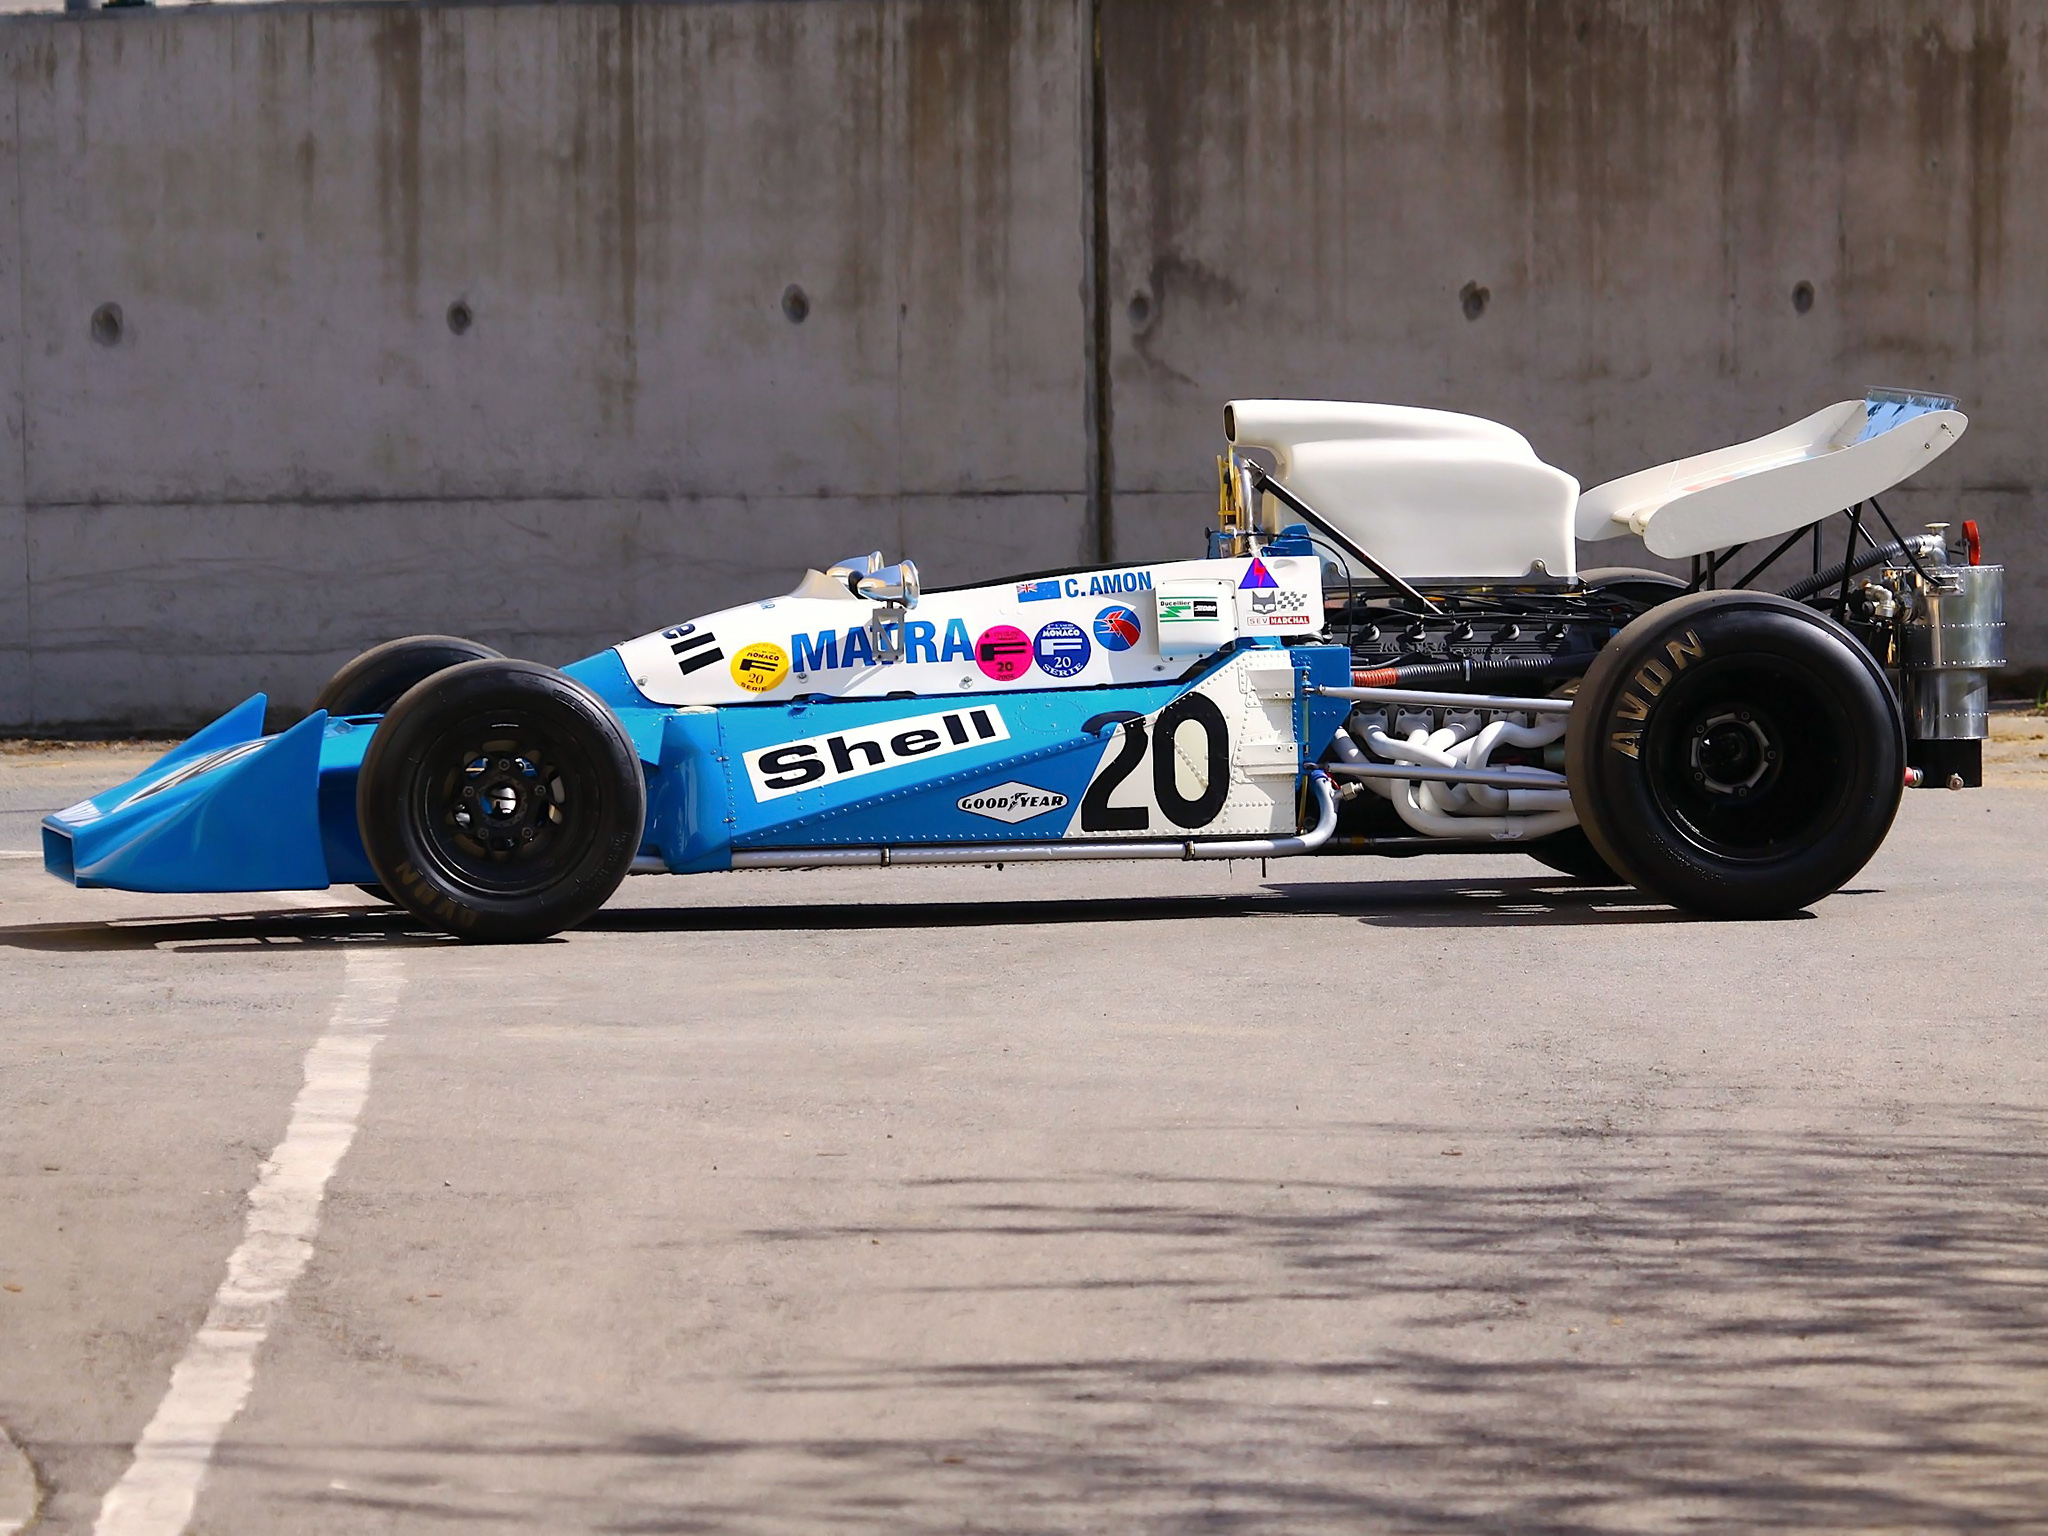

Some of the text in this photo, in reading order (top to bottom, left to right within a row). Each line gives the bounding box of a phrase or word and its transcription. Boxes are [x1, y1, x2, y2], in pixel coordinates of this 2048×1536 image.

[1089, 571, 1152, 596] AMON
[1270, 616, 1309, 625] MARCHAL
[1042, 629, 1081, 637] MONACO
[746, 652, 780, 662] MONACO
[1053, 656, 1071, 668] 20
[997, 661, 1014, 672] 20
[1042, 662, 1084, 677] SERIE
[748, 673, 764, 685] 20
[1610, 628, 1706, 760] AVON
[758, 709, 996, 790] Shell
[1081, 691, 1230, 832] 20
